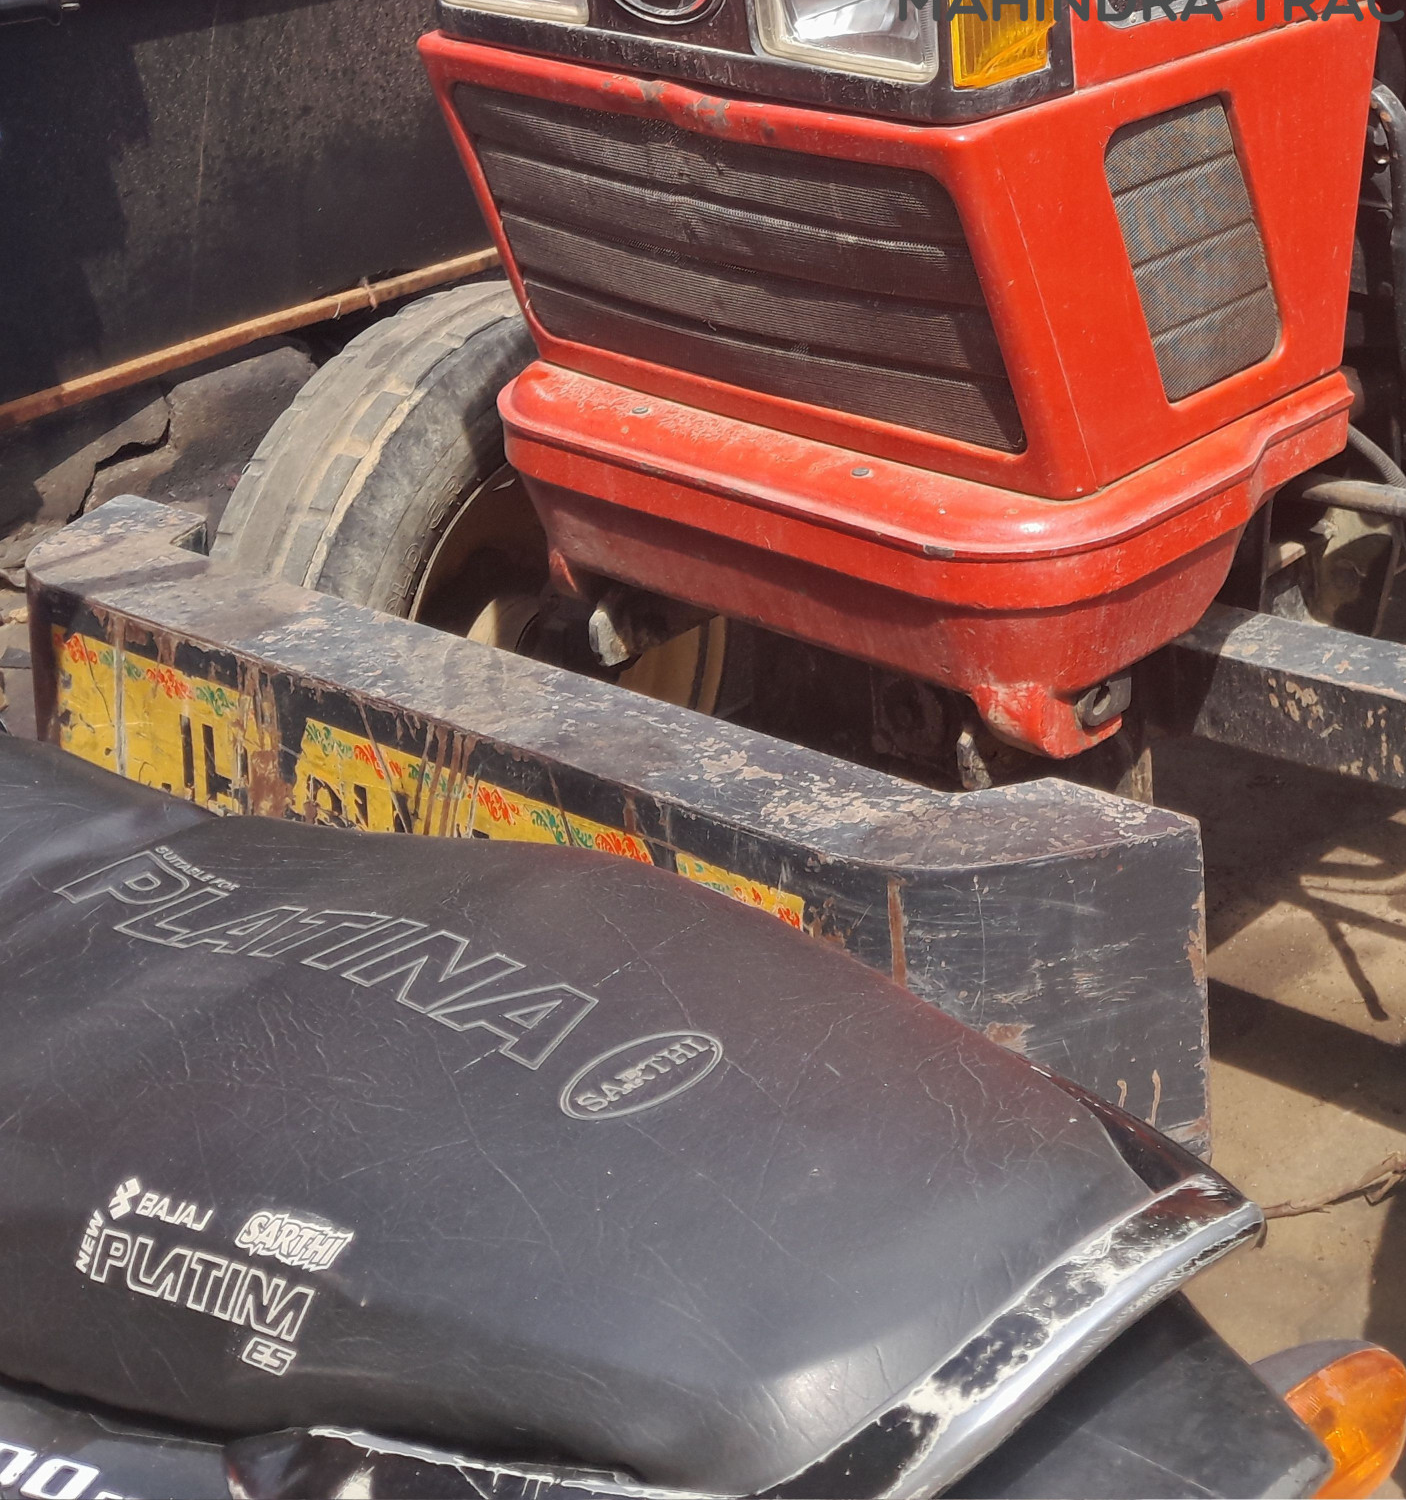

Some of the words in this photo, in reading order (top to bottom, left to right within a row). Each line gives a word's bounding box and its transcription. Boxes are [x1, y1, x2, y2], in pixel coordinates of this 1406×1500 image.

[154, 845, 216, 882] SUITABLE
[54, 850, 599, 1071] PLATINA
[574, 1036, 711, 1113] SARTHI
[75, 1209, 105, 1274] NEW
[135, 1192, 214, 1232] BAJAJ
[238, 1211, 352, 1271] SARTHI
[89, 1228, 315, 1342] PLATINA
[241, 1336, 297, 1377] ES
